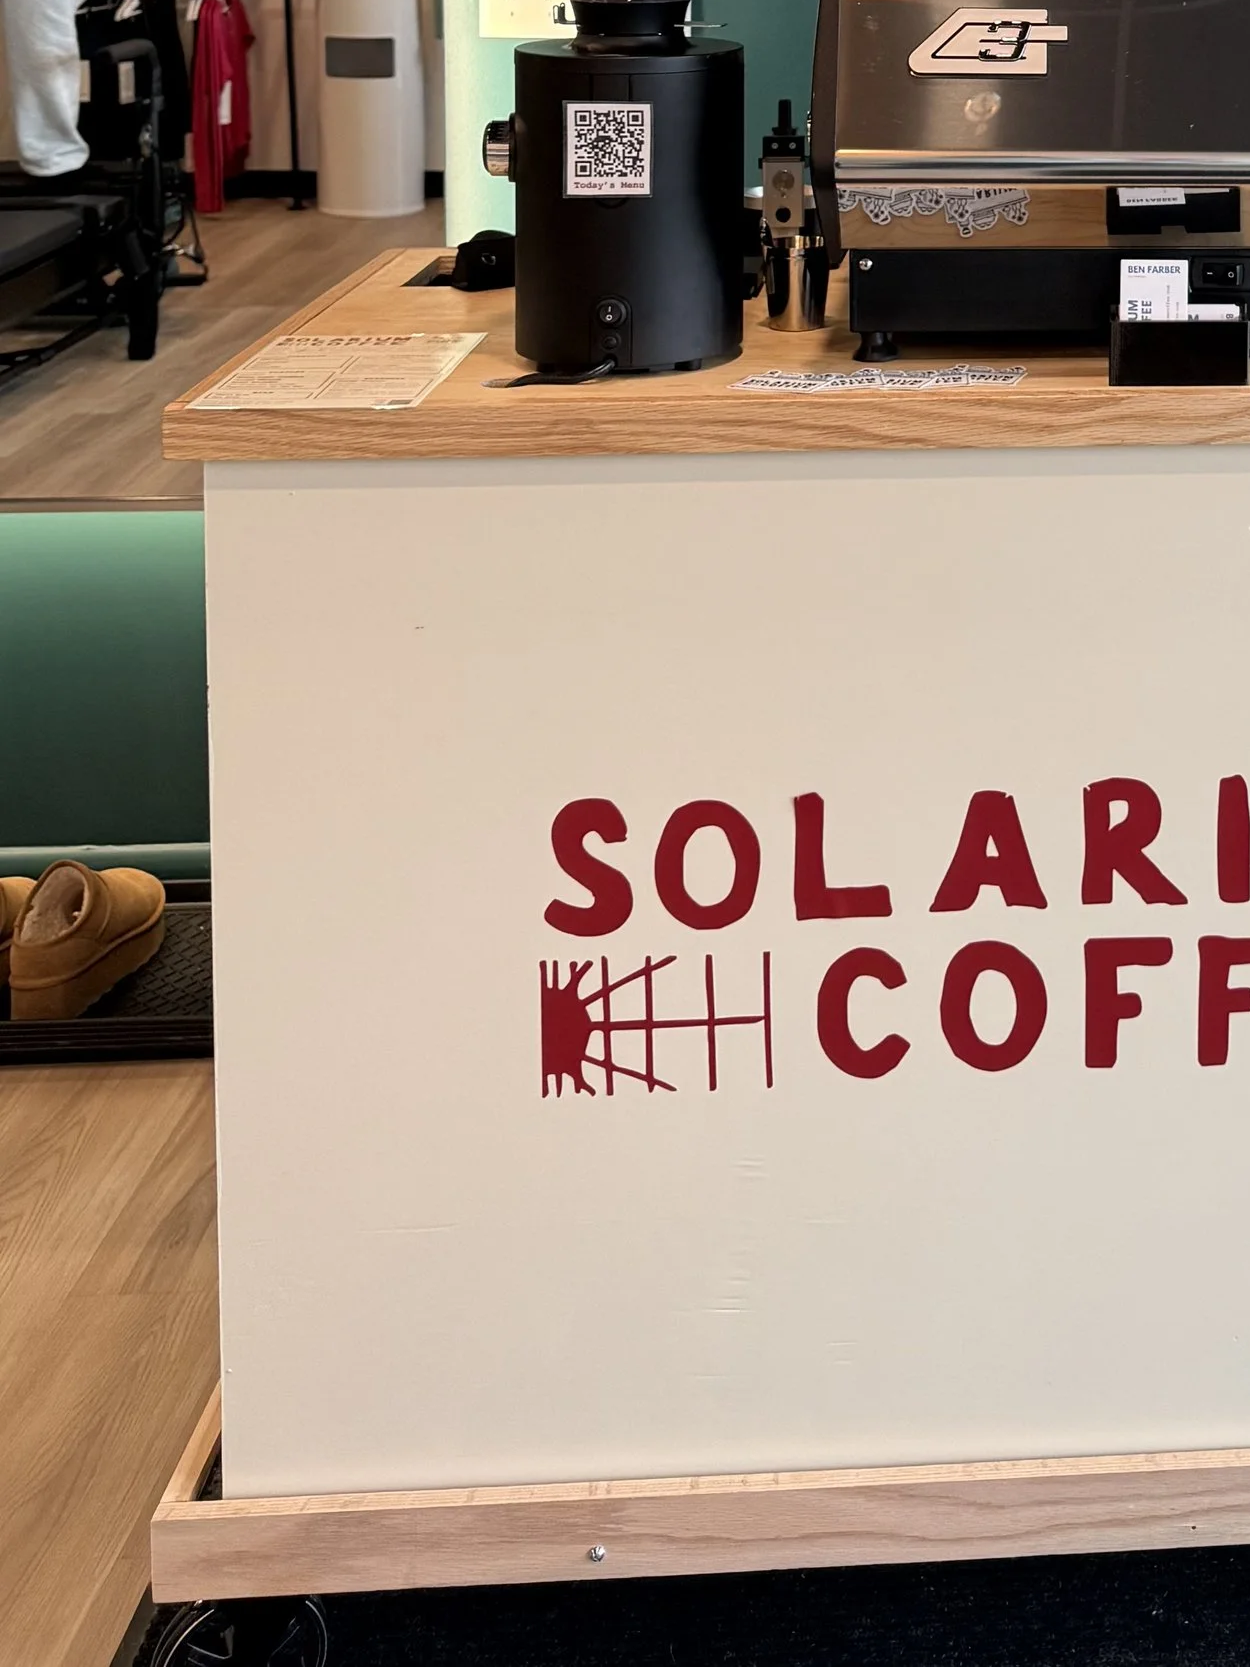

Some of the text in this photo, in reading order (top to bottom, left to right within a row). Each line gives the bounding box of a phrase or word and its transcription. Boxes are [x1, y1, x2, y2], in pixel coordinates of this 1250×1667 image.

[573, 181, 616, 190] Today's
[1127, 265, 1181, 274] BEN FARBER
